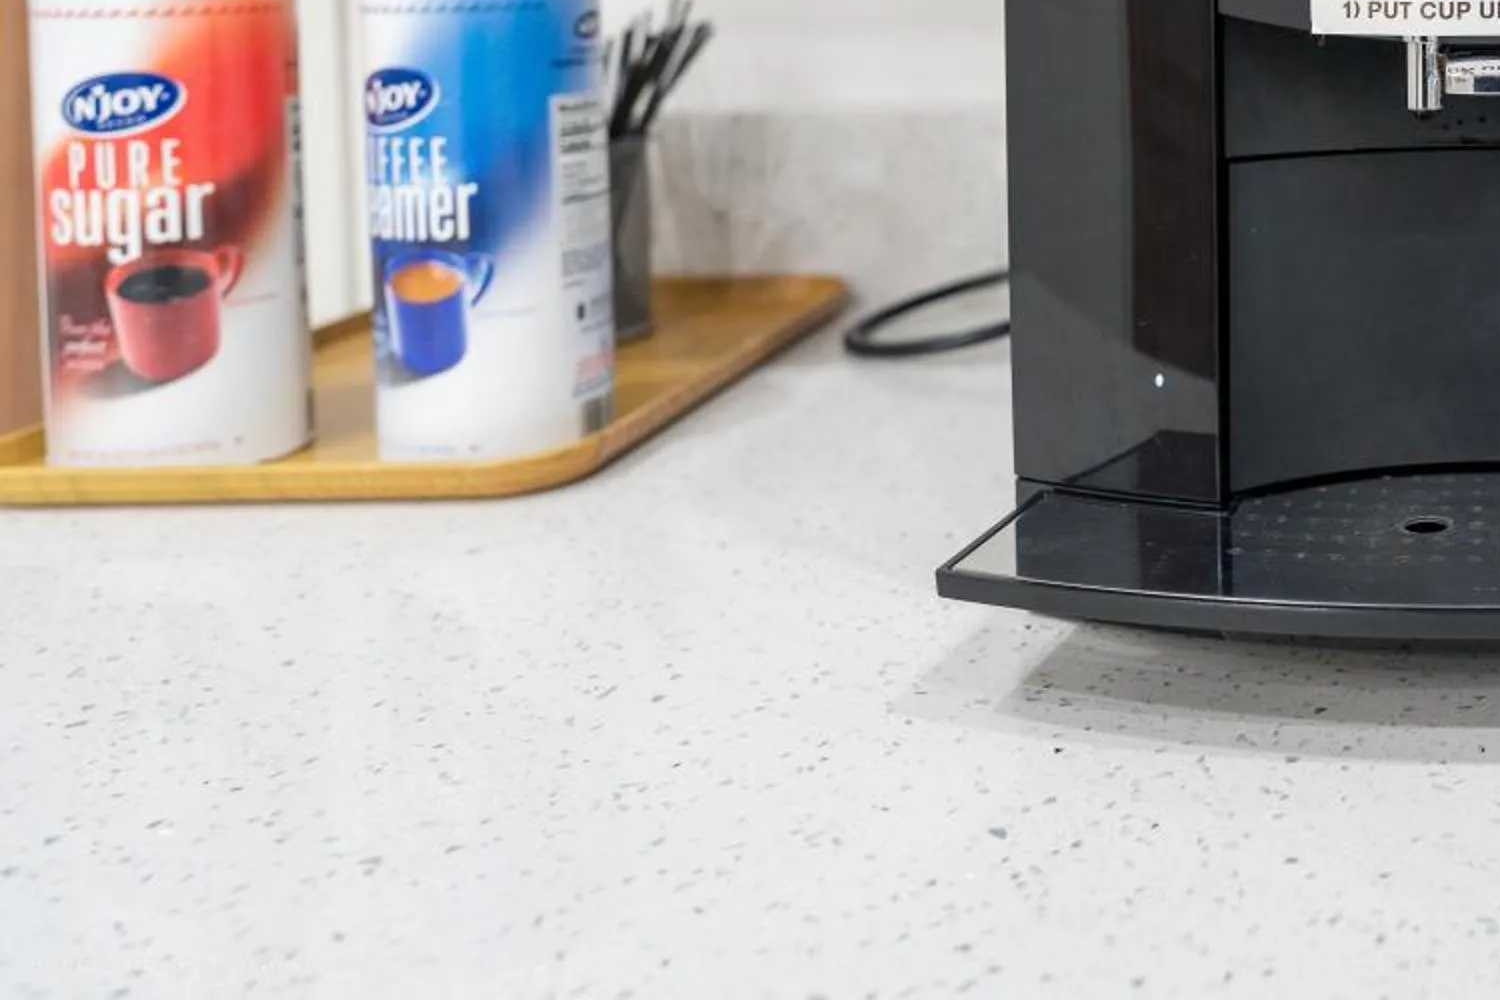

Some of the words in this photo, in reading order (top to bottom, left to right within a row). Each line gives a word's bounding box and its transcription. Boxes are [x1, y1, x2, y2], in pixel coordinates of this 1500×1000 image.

[1342, 2, 1361, 19] 1)
[1367, 1, 1413, 20] PUT
[1419, 1, 1471, 20] CUP
[67, 138, 183, 190] PURE
[367, 135, 448, 186] FFEE
[51, 180, 217, 267] sugar
[367, 181, 479, 243] amer
